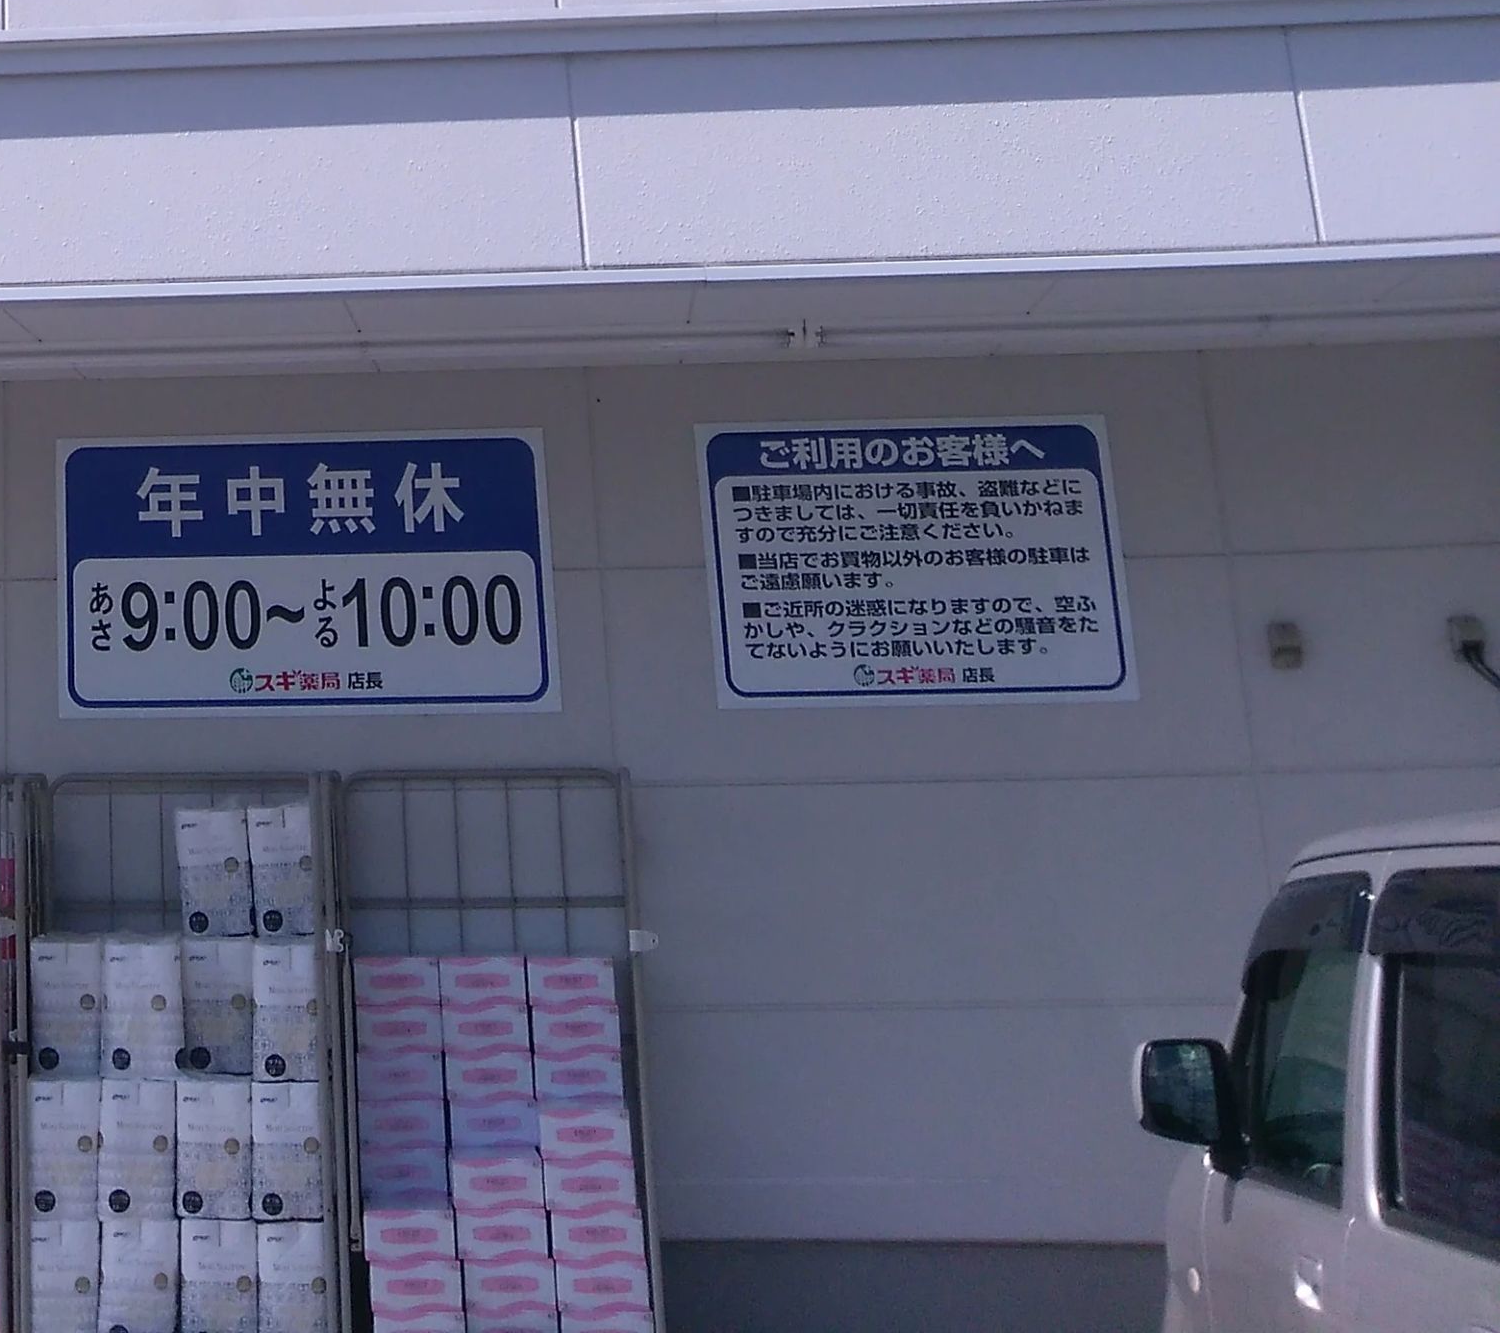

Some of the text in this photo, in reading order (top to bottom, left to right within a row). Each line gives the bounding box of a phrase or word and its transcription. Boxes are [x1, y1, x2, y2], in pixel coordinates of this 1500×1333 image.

[758, 432, 1046, 471] ご利用のお客様へ
[136, 462, 465, 539] 年中無休
[254, 669, 384, 691] スギ薬局 店長
[877, 666, 996, 685] スギ薬局 店長
